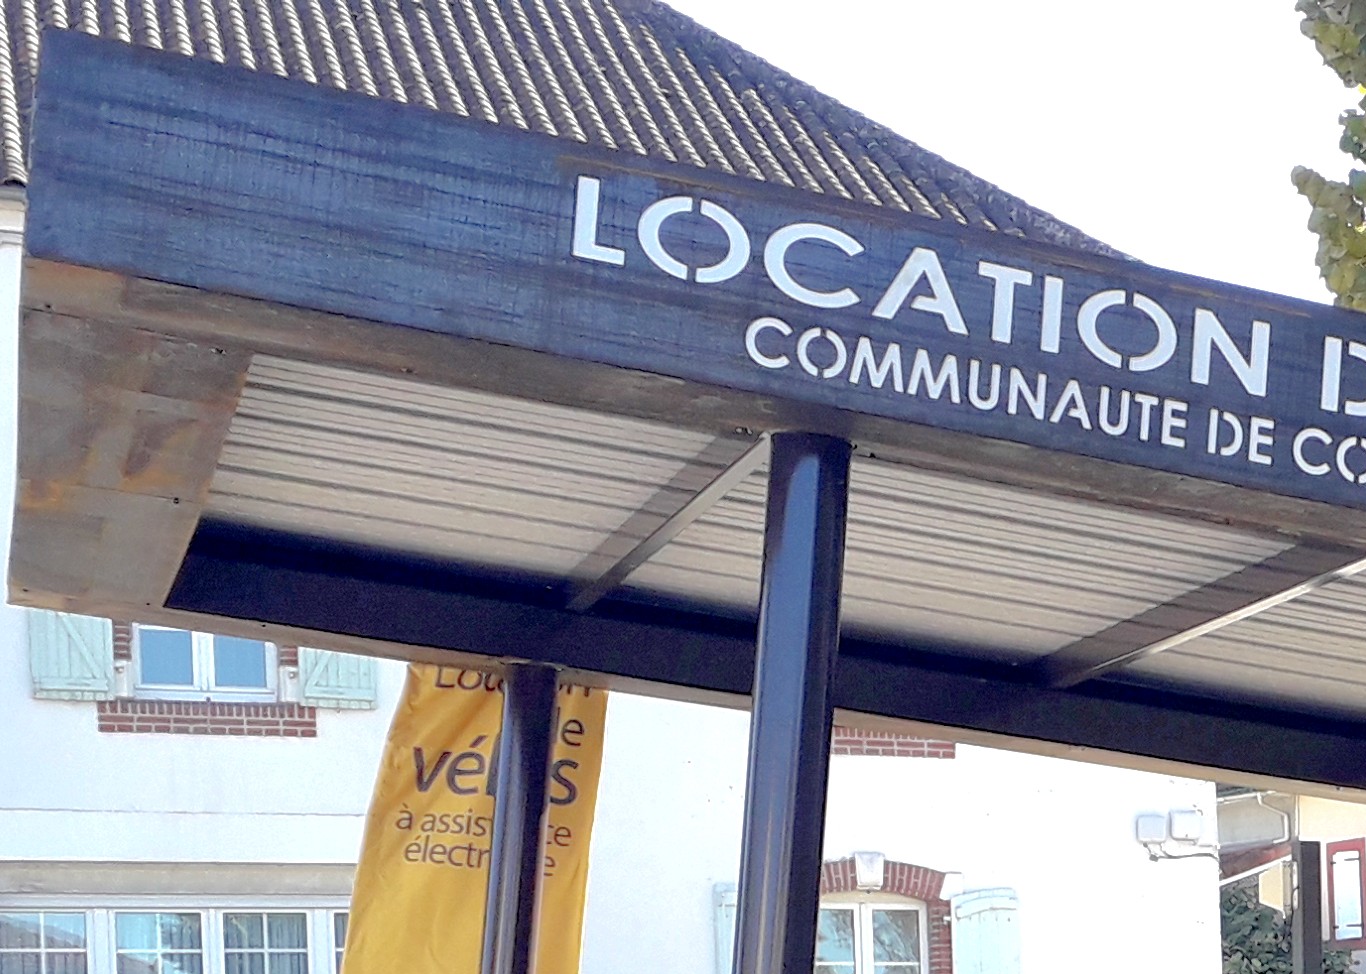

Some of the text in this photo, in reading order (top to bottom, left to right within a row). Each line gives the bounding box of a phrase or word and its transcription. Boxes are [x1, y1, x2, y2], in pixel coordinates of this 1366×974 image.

[571, 174, 1273, 397] LOCATION
[744, 315, 1189, 449] COMMUNAUTE
[1206, 407, 1276, 466] DE
[412, 733, 580, 806] véls
[395, 804, 572, 848] à assise
[403, 834, 556, 877] électre
